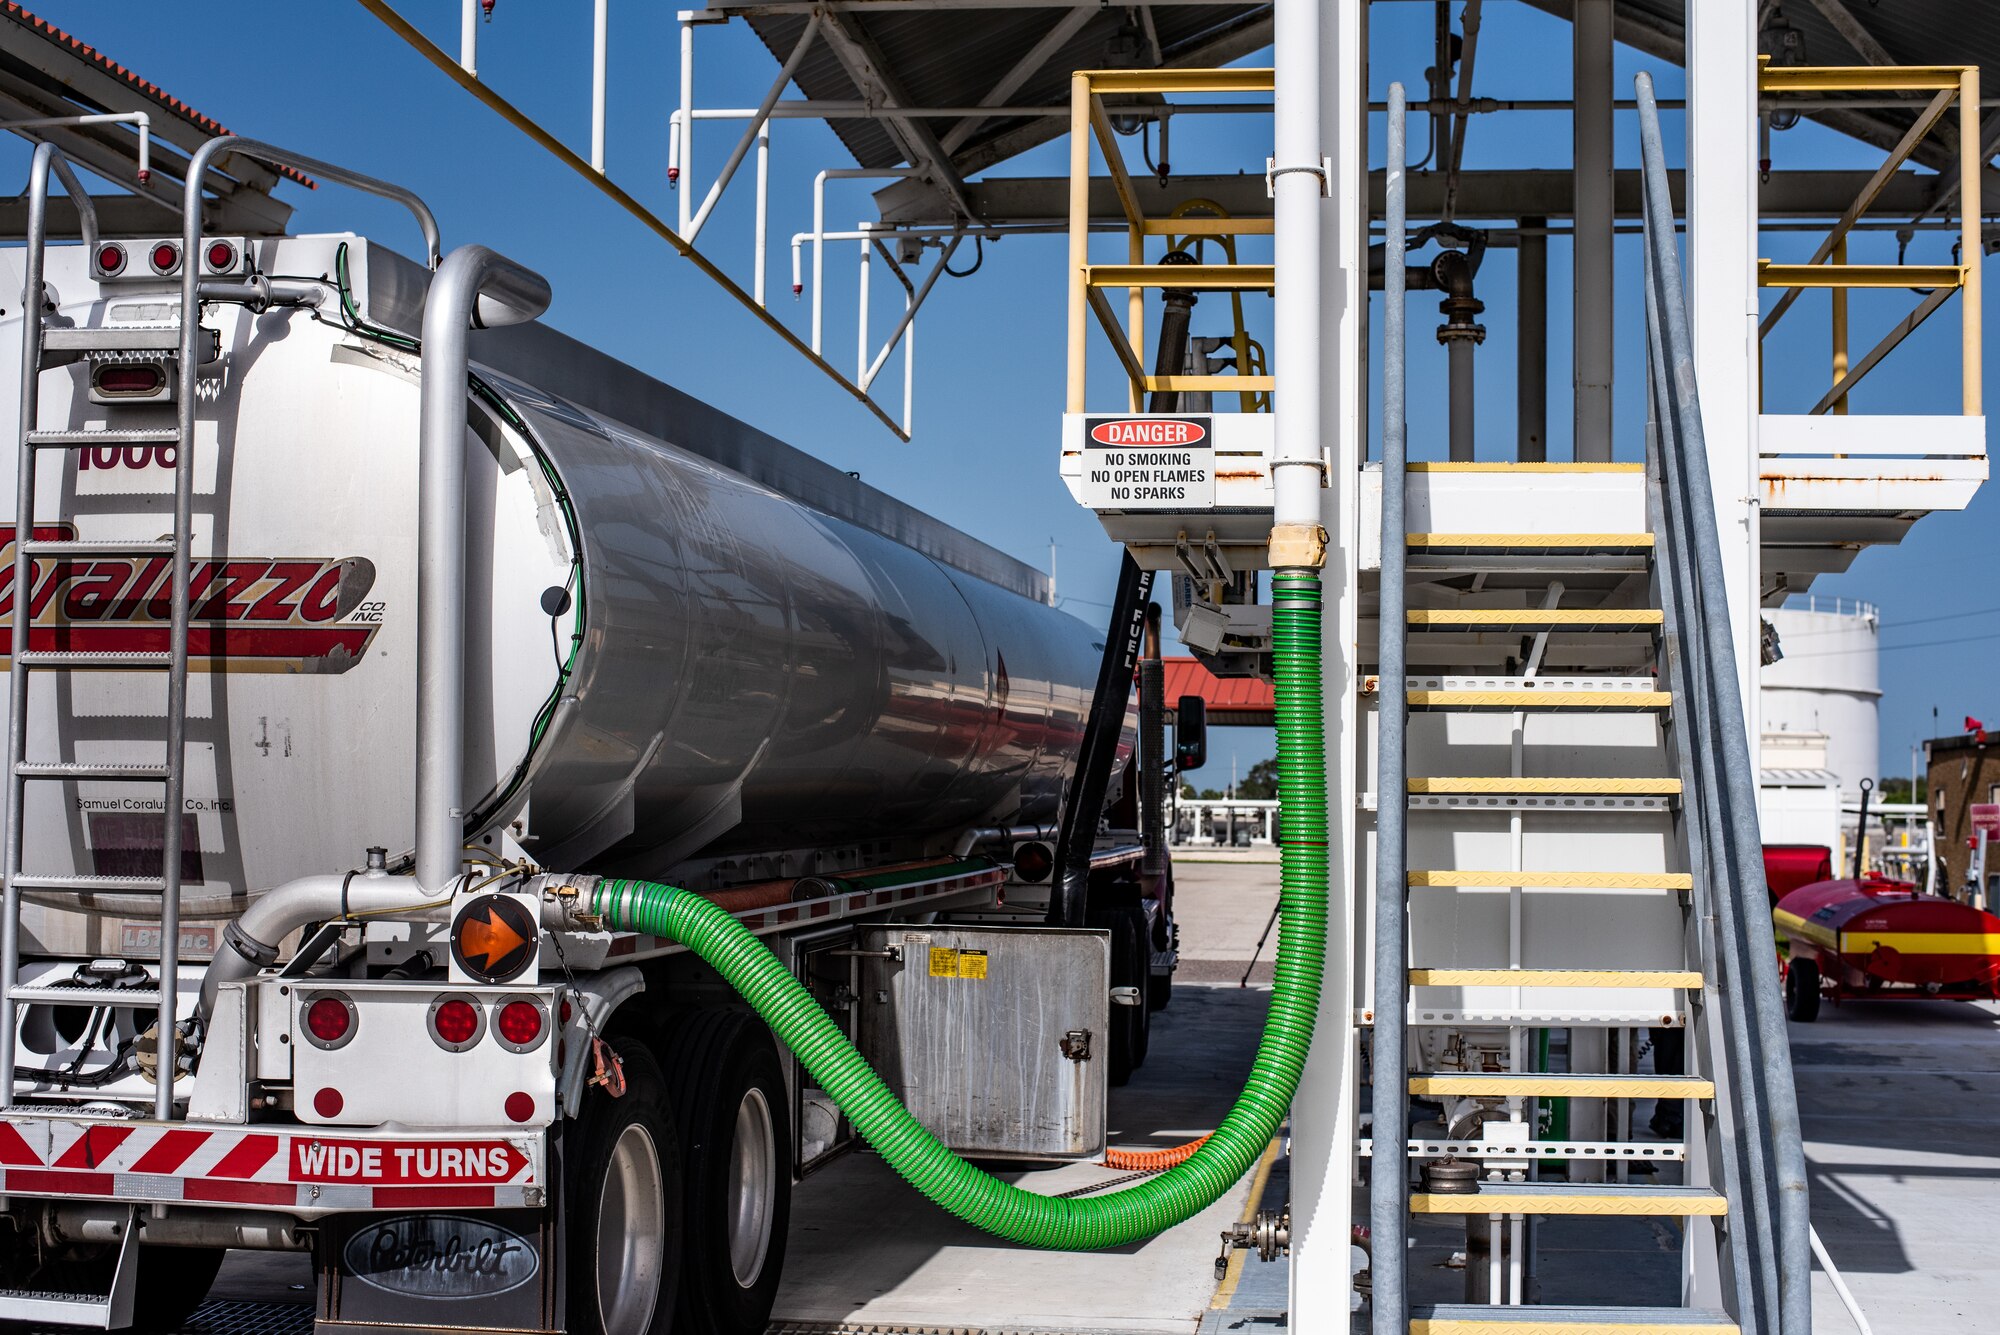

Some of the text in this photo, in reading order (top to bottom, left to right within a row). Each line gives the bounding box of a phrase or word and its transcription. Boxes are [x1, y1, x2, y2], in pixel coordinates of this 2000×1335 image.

[1108, 424, 1187, 442] DANGER
[1105, 453, 1191, 466] NO SMOKING
[1091, 469, 1205, 483] NO OPEN FLAMES
[1111, 487, 1185, 500] NO SPARKS
[0, 542, 375, 623] oraluzzo
[359, 602, 386, 611] CO.
[351, 612, 383, 621] INC.
[1124, 571, 1151, 669] ET FUEL
[76, 799, 121, 810] Samuel
[123, 799, 167, 810] Coralu
[185, 799, 208, 811] Co.,
[180, 934, 212, 949] nc.
[298, 1144, 510, 1178] WIDE TURNS
